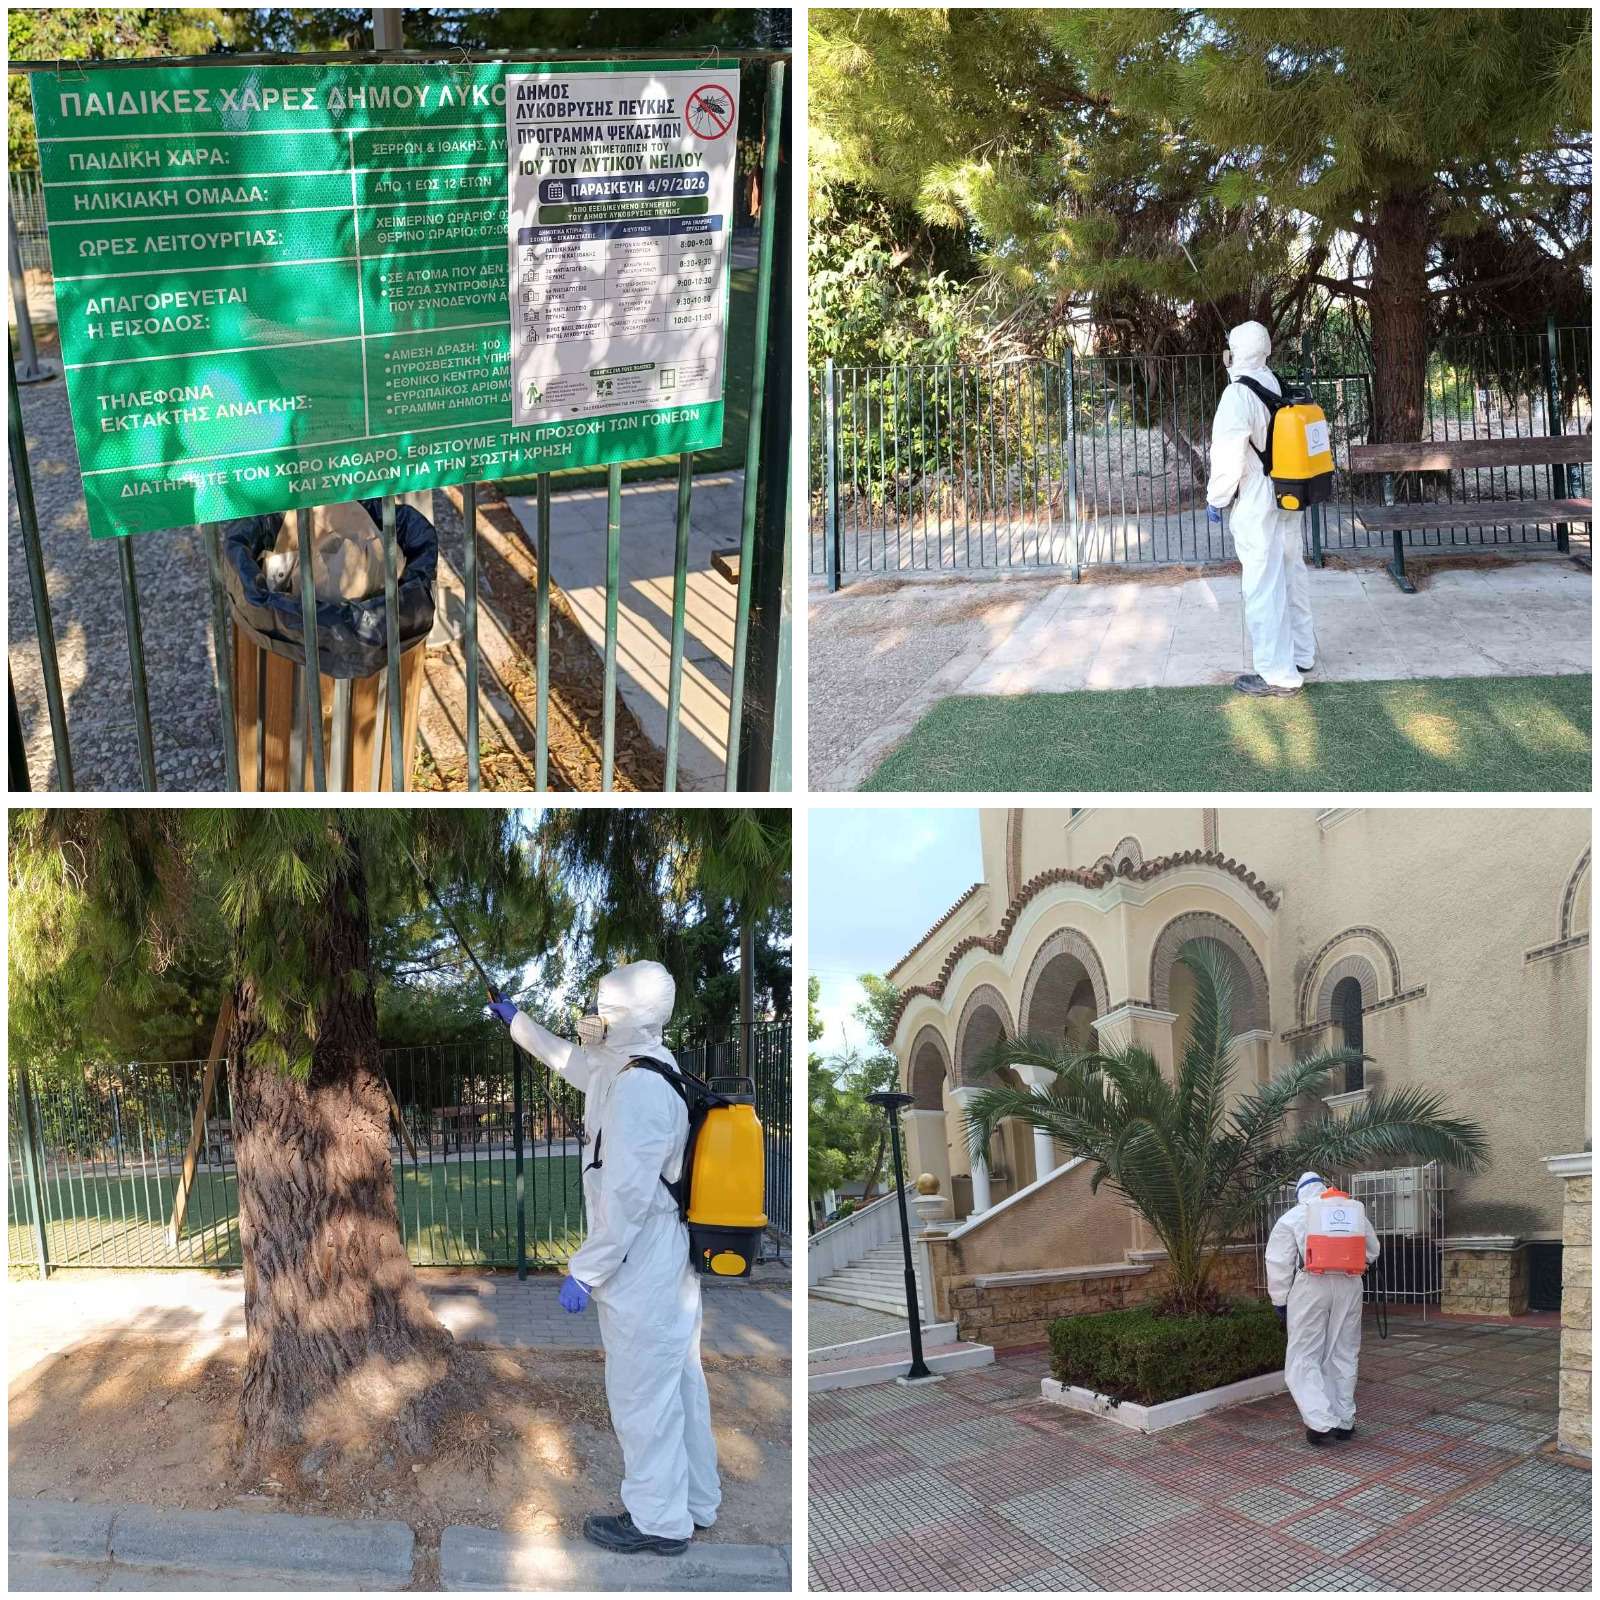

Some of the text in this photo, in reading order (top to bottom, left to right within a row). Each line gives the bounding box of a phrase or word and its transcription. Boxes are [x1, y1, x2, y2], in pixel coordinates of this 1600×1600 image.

[60, 88, 212, 118] ΠΑΙΔΙΚΕΣ
[219, 87, 319, 113] ΧΑΡΕΣ
[327, 84, 430, 110] ΔΗΜΟΥ
[516, 84, 569, 100] ΔΗΜΟΣ
[516, 99, 675, 119] ΛΥΚΟΒΡΥΣΗΣ ΠΕΥΚΗΣ
[517, 122, 681, 144] ΠΡΟΓΡΑΜΜΑ ΨΕΚΑΣΜΩΝ
[372, 142, 422, 155] ΣΕΡΡΩΝ
[427, 143, 434, 152] &
[438, 140, 487, 152] ΙΘΑΚΗΣ,
[540, 142, 669, 157] ΓΙΑ ΤΗΝ ΑΝΤΙΜΕΤΩΠΙΣΗ ΤΟΥ
[69, 148, 230, 170] ΠΑΙΔΙΚΗ ΧΑΡΑ:
[519, 152, 703, 176] ΙΟΥ ΤΟΥ ΔΥΤΙΚΟΥ ΝΕΙΛΟΥ
[375, 176, 492, 193] ΑΠΟ 1 ΕΩΣ 12 ΕΤΩΝ
[571, 177, 705, 197] ΠΑΡΑΣΚΕΥΗ 4/9/2026
[74, 185, 268, 211] ΗΛΙΚΙΑΚΗ ΟΜΑΔΑ:
[376, 214, 444, 228] ΧΕΙΜΕΡΙΝΟ
[447, 210, 496, 224] ΩΡΑΡΙΟ:
[79, 229, 284, 258] ΩΡΕΣ ΛΕΙΤΟΥΡΓΙΑΣ:
[377, 230, 425, 244] ΘΕΡΙΝΟ
[429, 226, 477, 240] ΩΡΑΡΙΟ:
[388, 264, 503, 284] ΣΕ ΑΤΟΜΑ ΠΟΥ ΔΕΝ
[388, 278, 507, 298] ΣΕ ΖΩΑ ΣΥΝΤΡΟΦΙΑΣ
[84, 287, 248, 316] ΑΠΑΓΟΡΕΥΕΤΑΙ
[389, 300, 415, 312] ΠΟΥ
[418, 293, 496, 309] ΣΥΝΟΔΕΥΟΥΝ
[88, 314, 211, 340] Η ΕΙΣΟΔΟΣ:
[392, 340, 501, 361] ΑΜΕΣΗ ΔΡΑΣΗ: 100
[393, 355, 480, 374] ΠΥΡΟΣΒΕΣΤΙΚΗ
[393, 374, 439, 388] ΕΘΝΙΚΟ
[443, 368, 489, 382] ΚΕΝΤΡΟ
[98, 384, 214, 411] ΤΗΛΕΦΩΝΑ
[394, 401, 445, 416] ΓΡΑΜΜΗ
[448, 394, 498, 409] ΔΗΜΟΤΗ
[101, 394, 312, 433] ΕΚΤΑΚΤΗΣ ΑΝΑΓΚΗΣ:
[120, 409, 699, 498] ΔΙΑΤΗΡΕΤΕ ΤΟΝ ΧΩΡΟ ΚΑΘΑΡΟ. ΕΦΙΣΤΟΥΜΕ ΤΗΝ ΠΡΟΣΟΧΗ ΤΩΝ ΓΟΝΕΩΝ
[288, 443, 572, 494] ΚΑΙ ΣΥΝΟΔΩΝ ΓΙΑ ΤΗΝ ΣΩΣΤΗ ΧΡΗΣΗ
